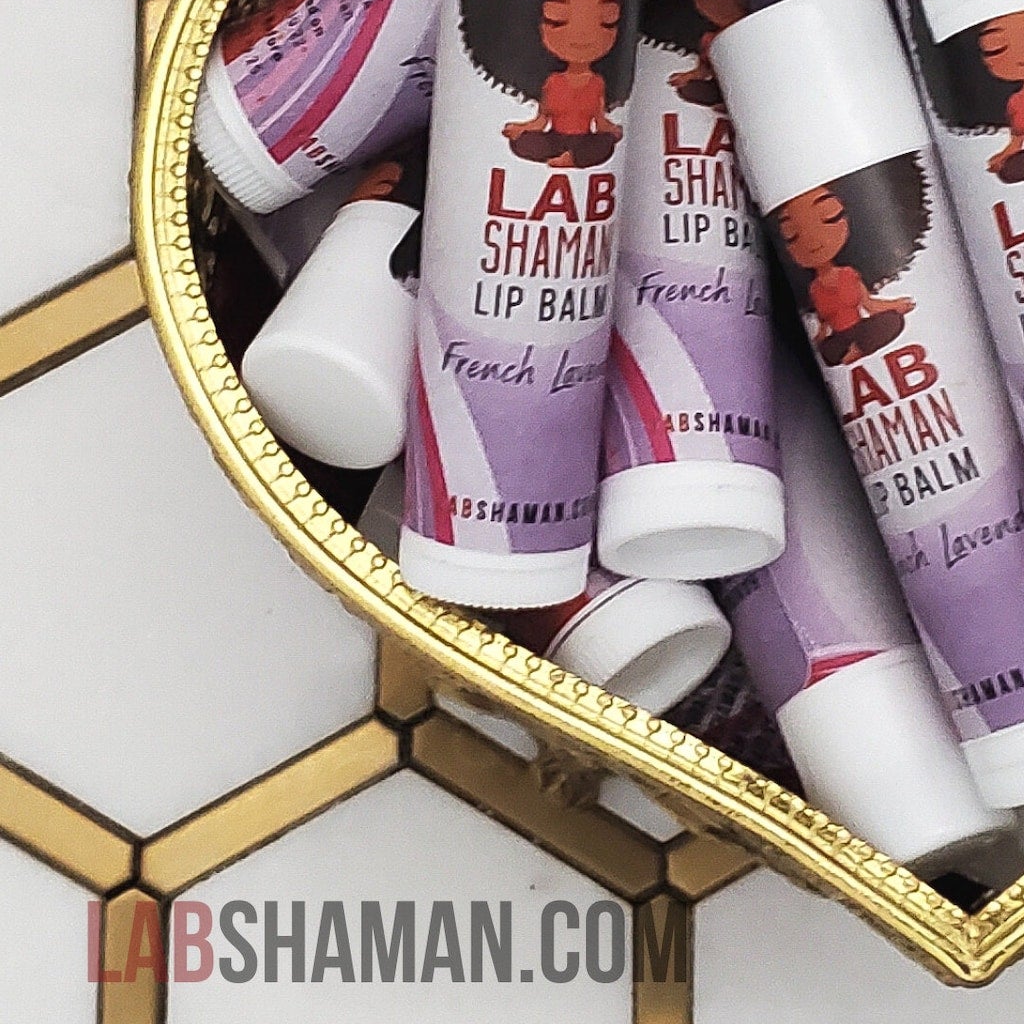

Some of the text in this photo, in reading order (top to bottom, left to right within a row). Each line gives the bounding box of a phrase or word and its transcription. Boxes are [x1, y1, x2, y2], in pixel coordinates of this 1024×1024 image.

[663, 113, 736, 157] LA
[487, 167, 616, 223] LAB
[664, 158, 739, 211] SHA
[663, 213, 710, 243] LIP
[474, 280, 524, 319] LIP
[636, 267, 731, 306] French
[442, 341, 534, 385] French
[842, 344, 939, 424] AB
[892, 446, 981, 507] BALM
